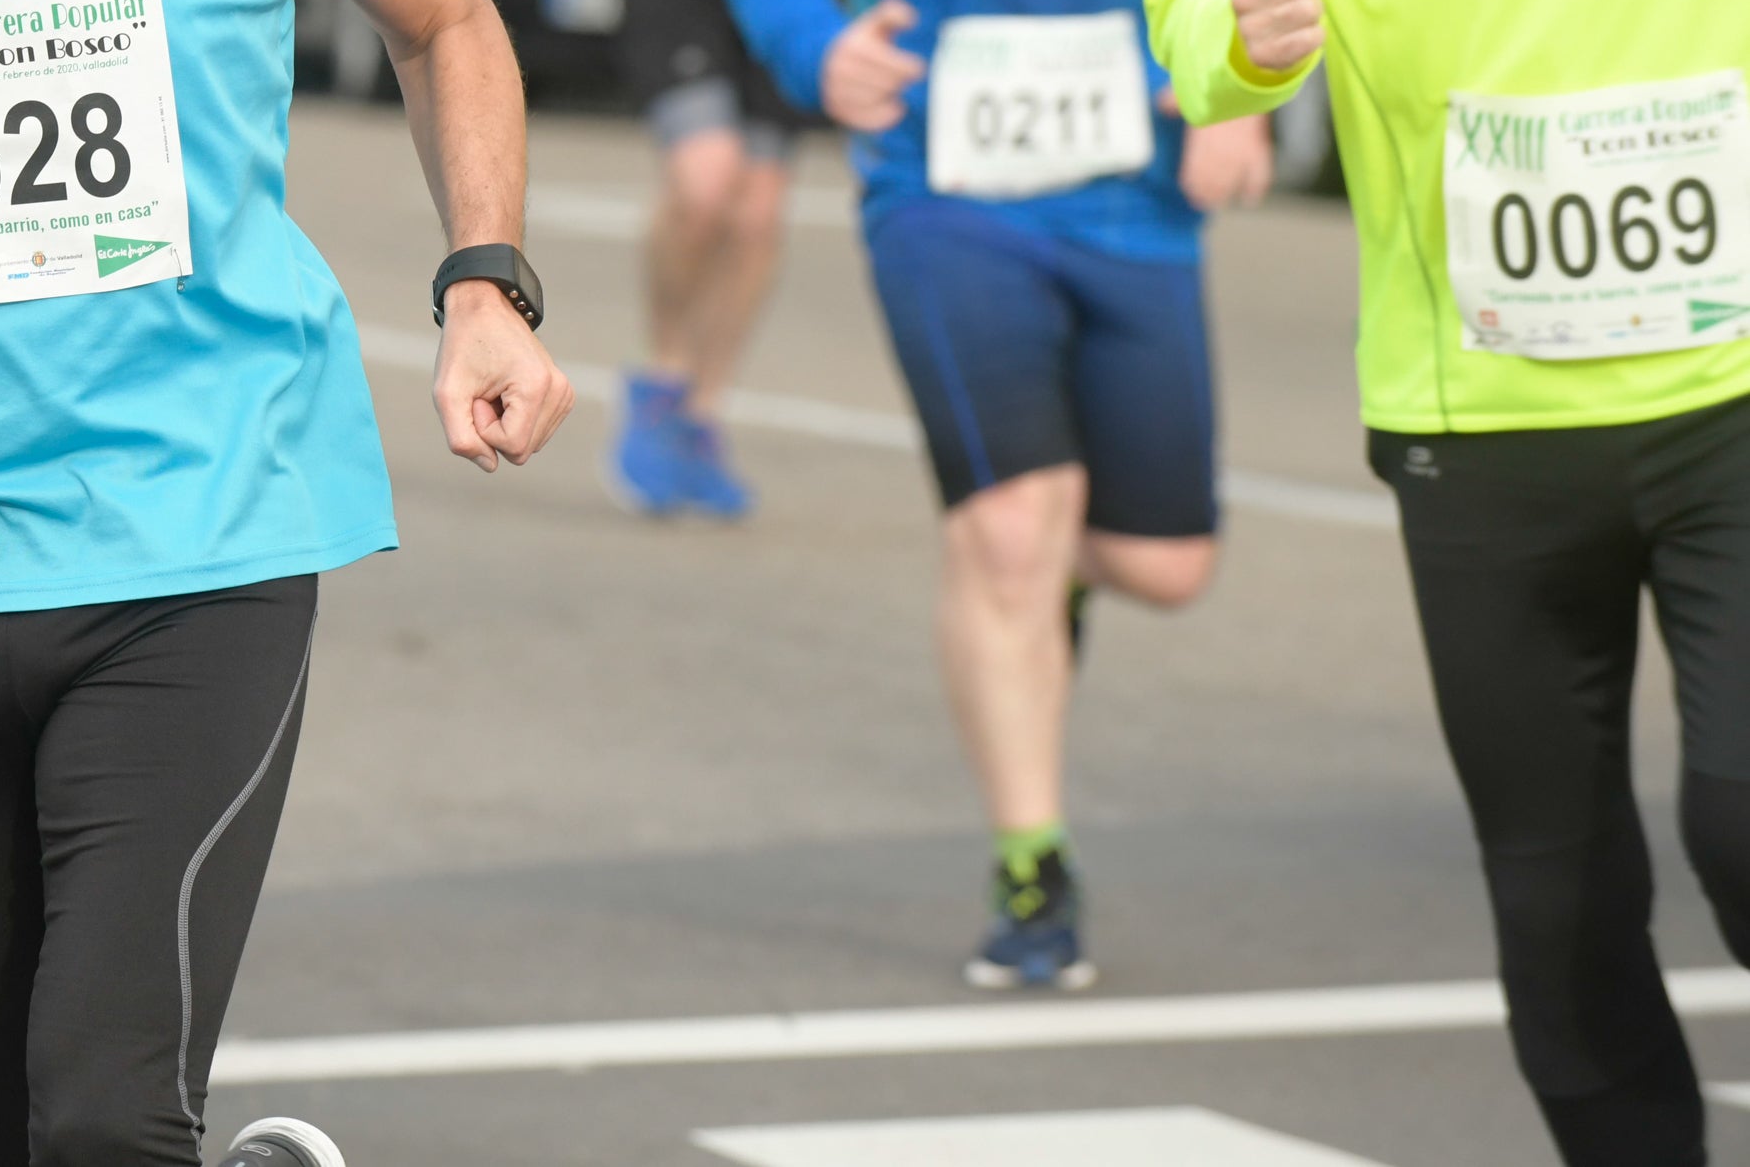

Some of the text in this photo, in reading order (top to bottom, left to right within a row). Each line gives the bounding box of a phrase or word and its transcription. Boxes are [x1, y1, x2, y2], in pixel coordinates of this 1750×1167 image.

[3, 67, 38, 81] febrero
[40, 65, 55, 76] de
[83, 56, 129, 71] Valladolid
[967, 88, 1111, 154] 0211
[1456, 105, 1548, 172] XXIII
[50, 215, 90, 230] como
[95, 211, 113, 225] en
[1492, 178, 1717, 280] 0069
